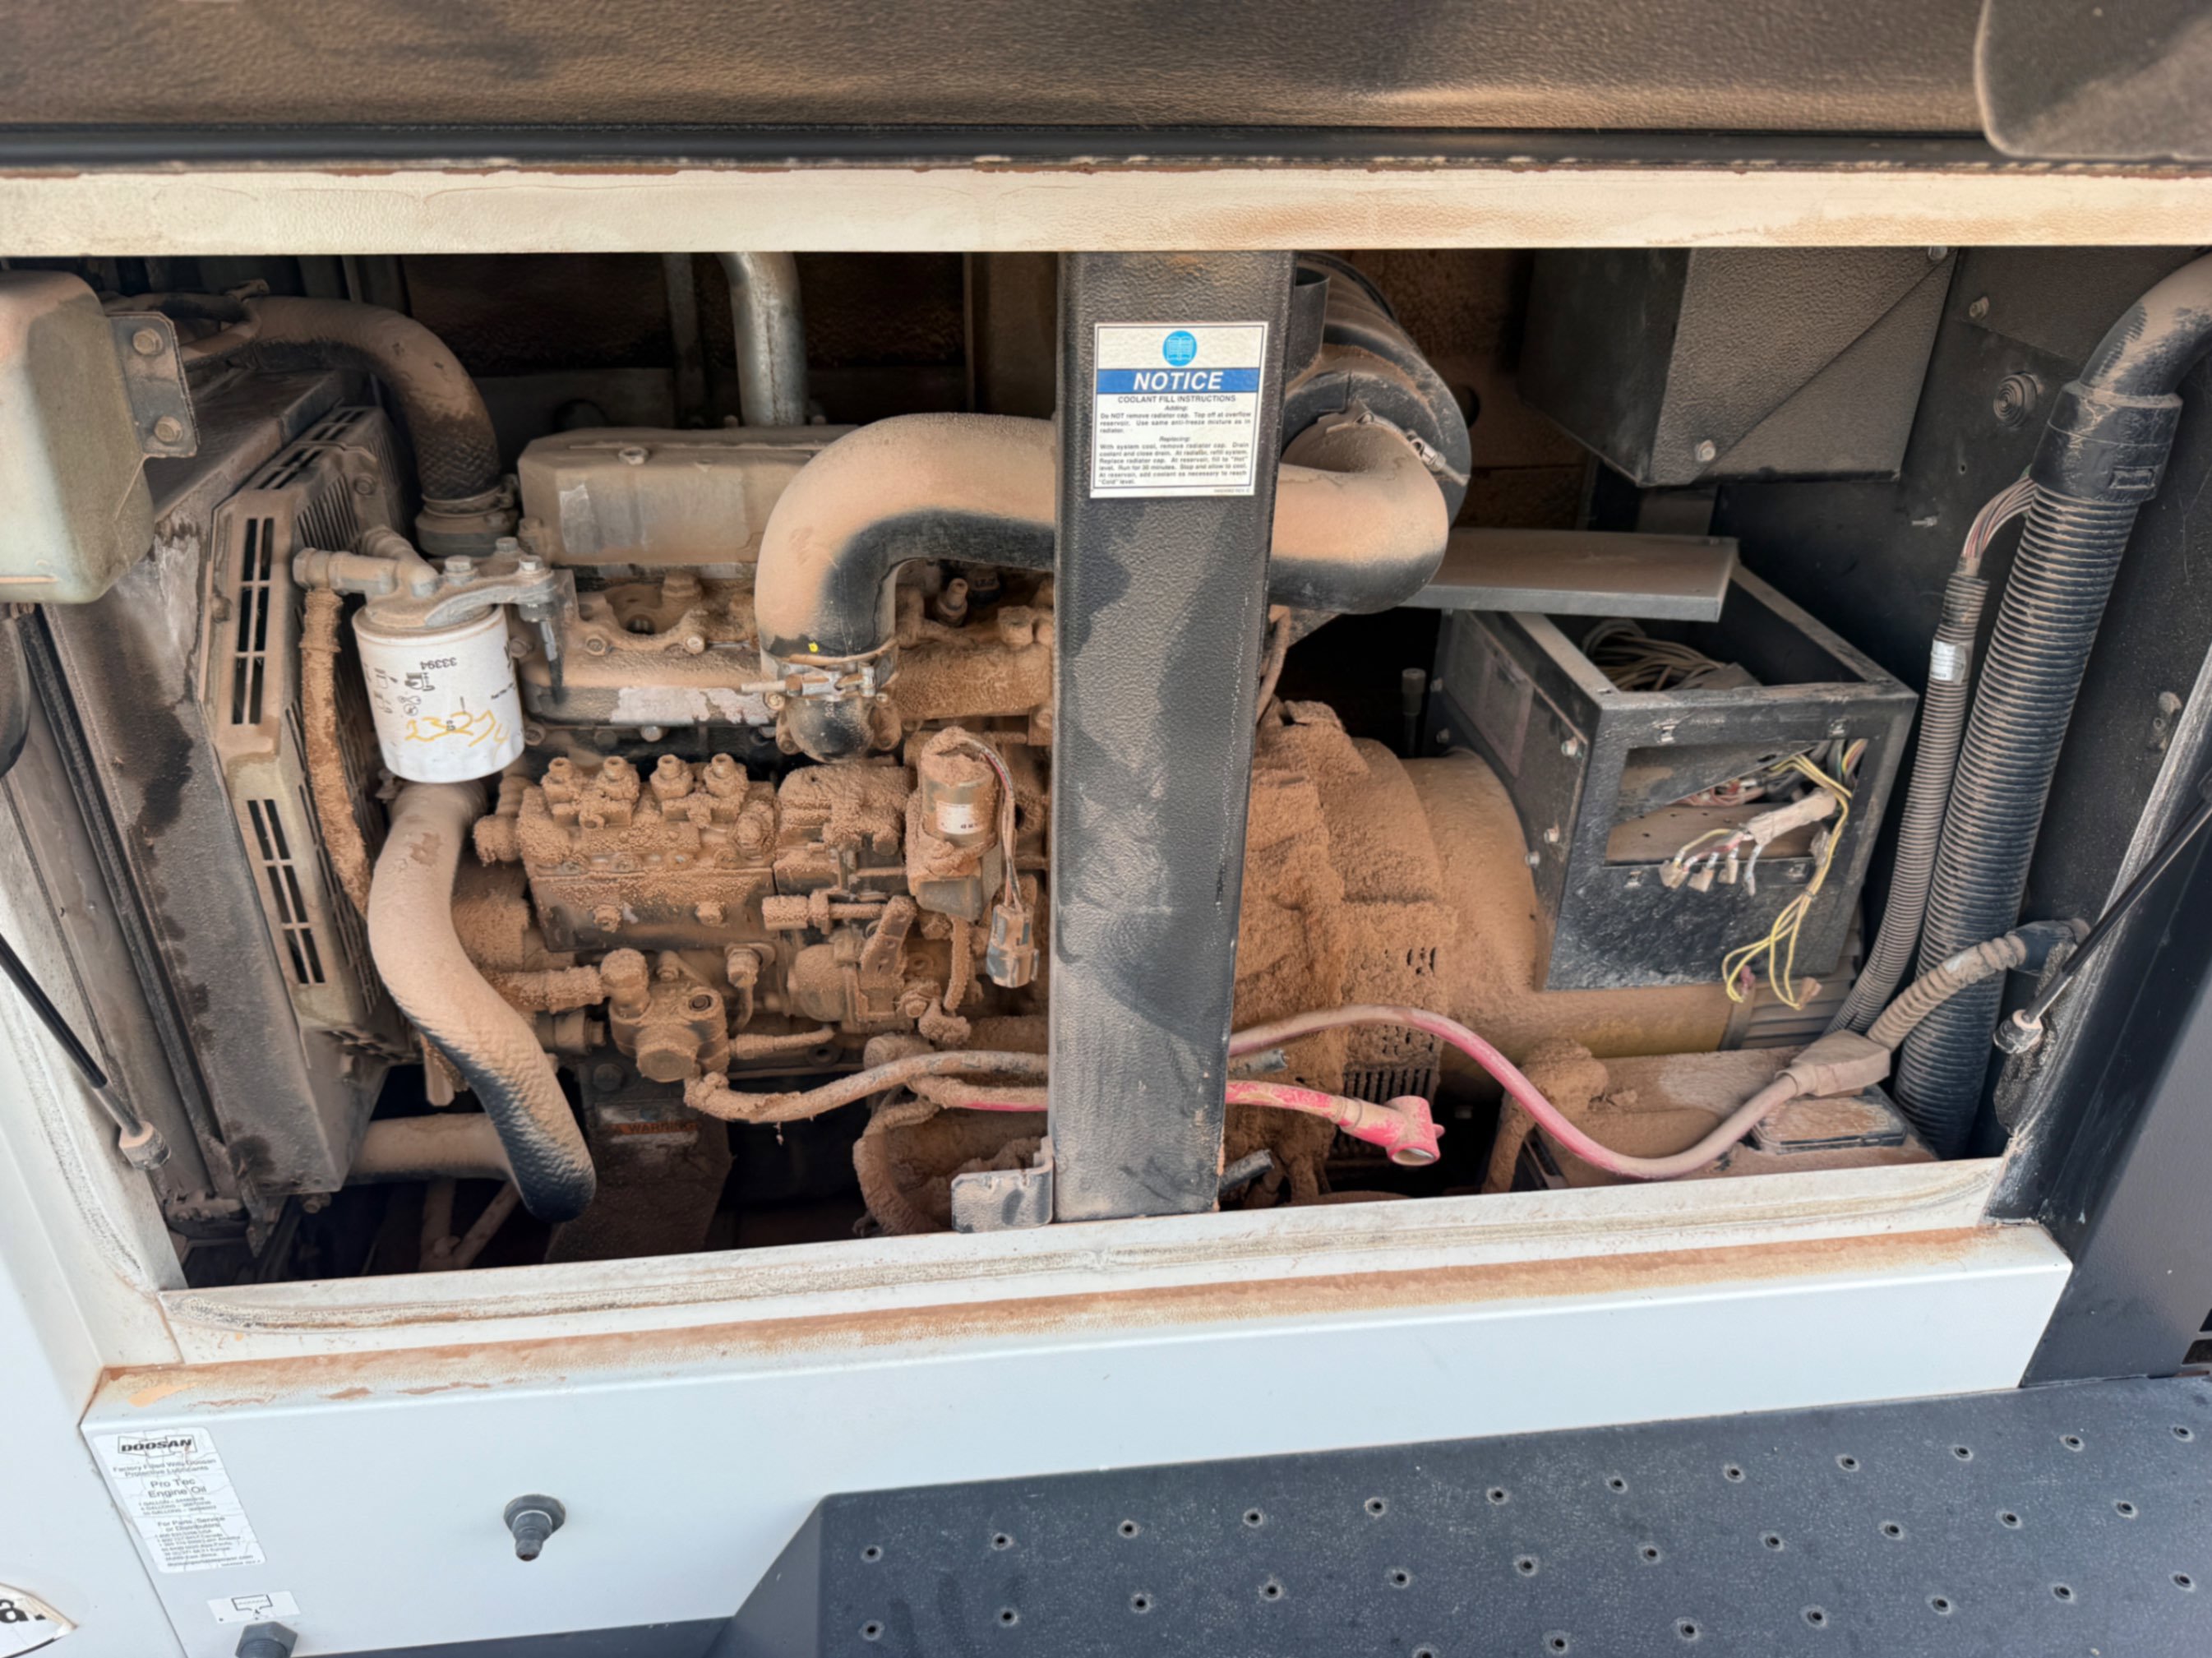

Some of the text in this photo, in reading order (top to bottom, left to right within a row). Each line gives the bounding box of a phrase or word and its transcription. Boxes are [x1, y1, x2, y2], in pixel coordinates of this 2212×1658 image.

[1134, 372, 1223, 390] NOTICE
[419, 657, 457, 669] 33394
[121, 1439, 192, 1452] DOOSAN
[150, 1480, 171, 1489] Pro
[148, 1485, 207, 1499] Engine Oil
